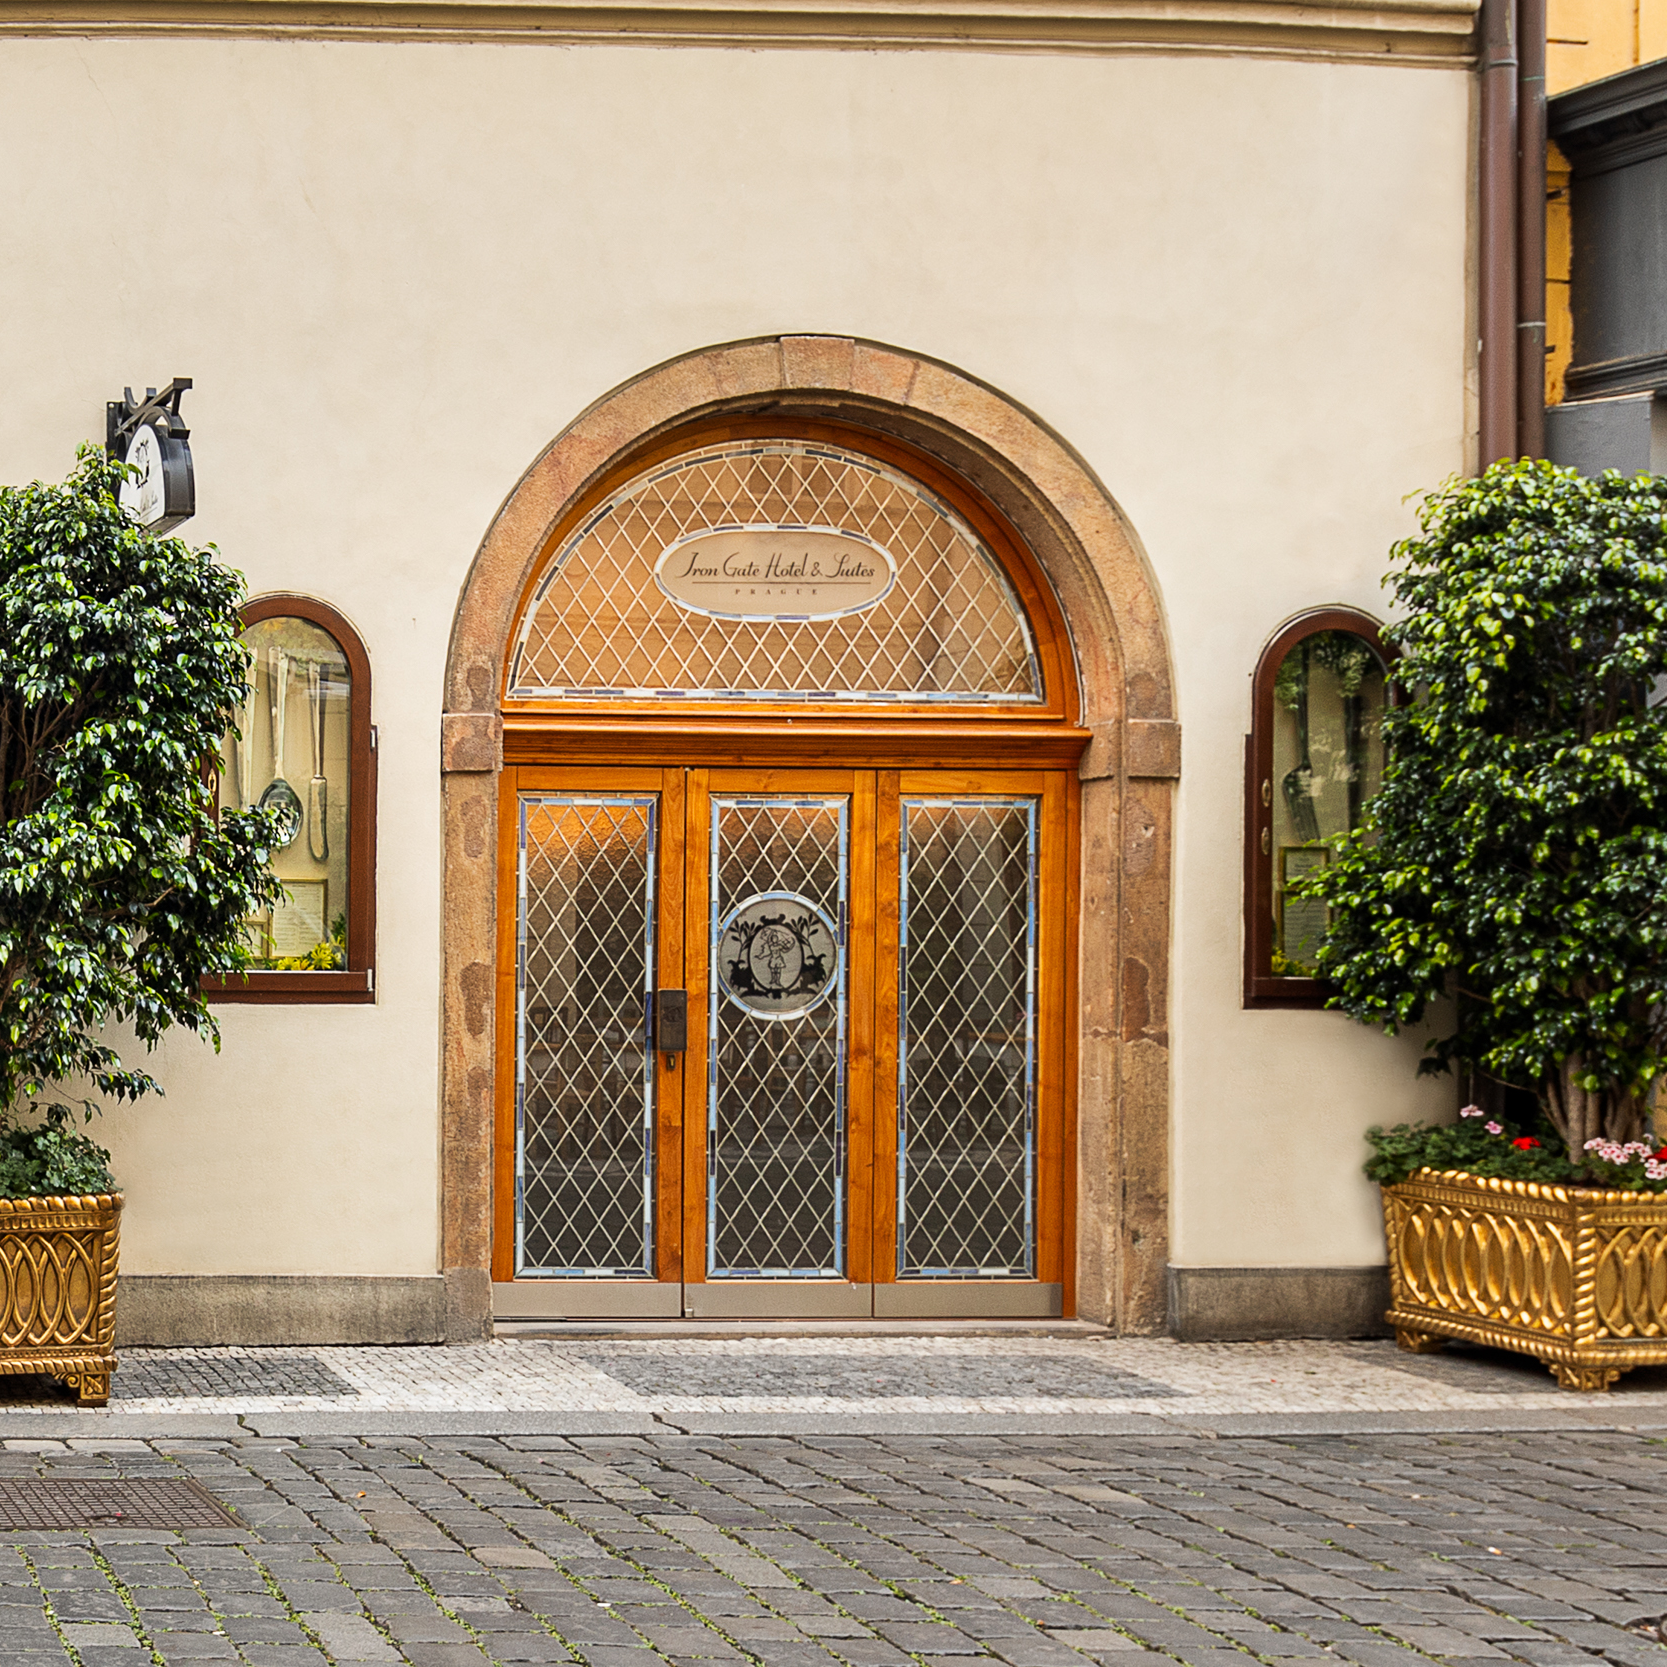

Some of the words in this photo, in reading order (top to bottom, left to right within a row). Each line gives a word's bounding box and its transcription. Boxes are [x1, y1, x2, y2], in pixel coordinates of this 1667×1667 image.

[675, 552, 719, 578] Iron
[723, 552, 760, 578] Gate
[765, 552, 808, 578] Hotel
[811, 562, 823, 577] &
[825, 552, 875, 578] Suites
